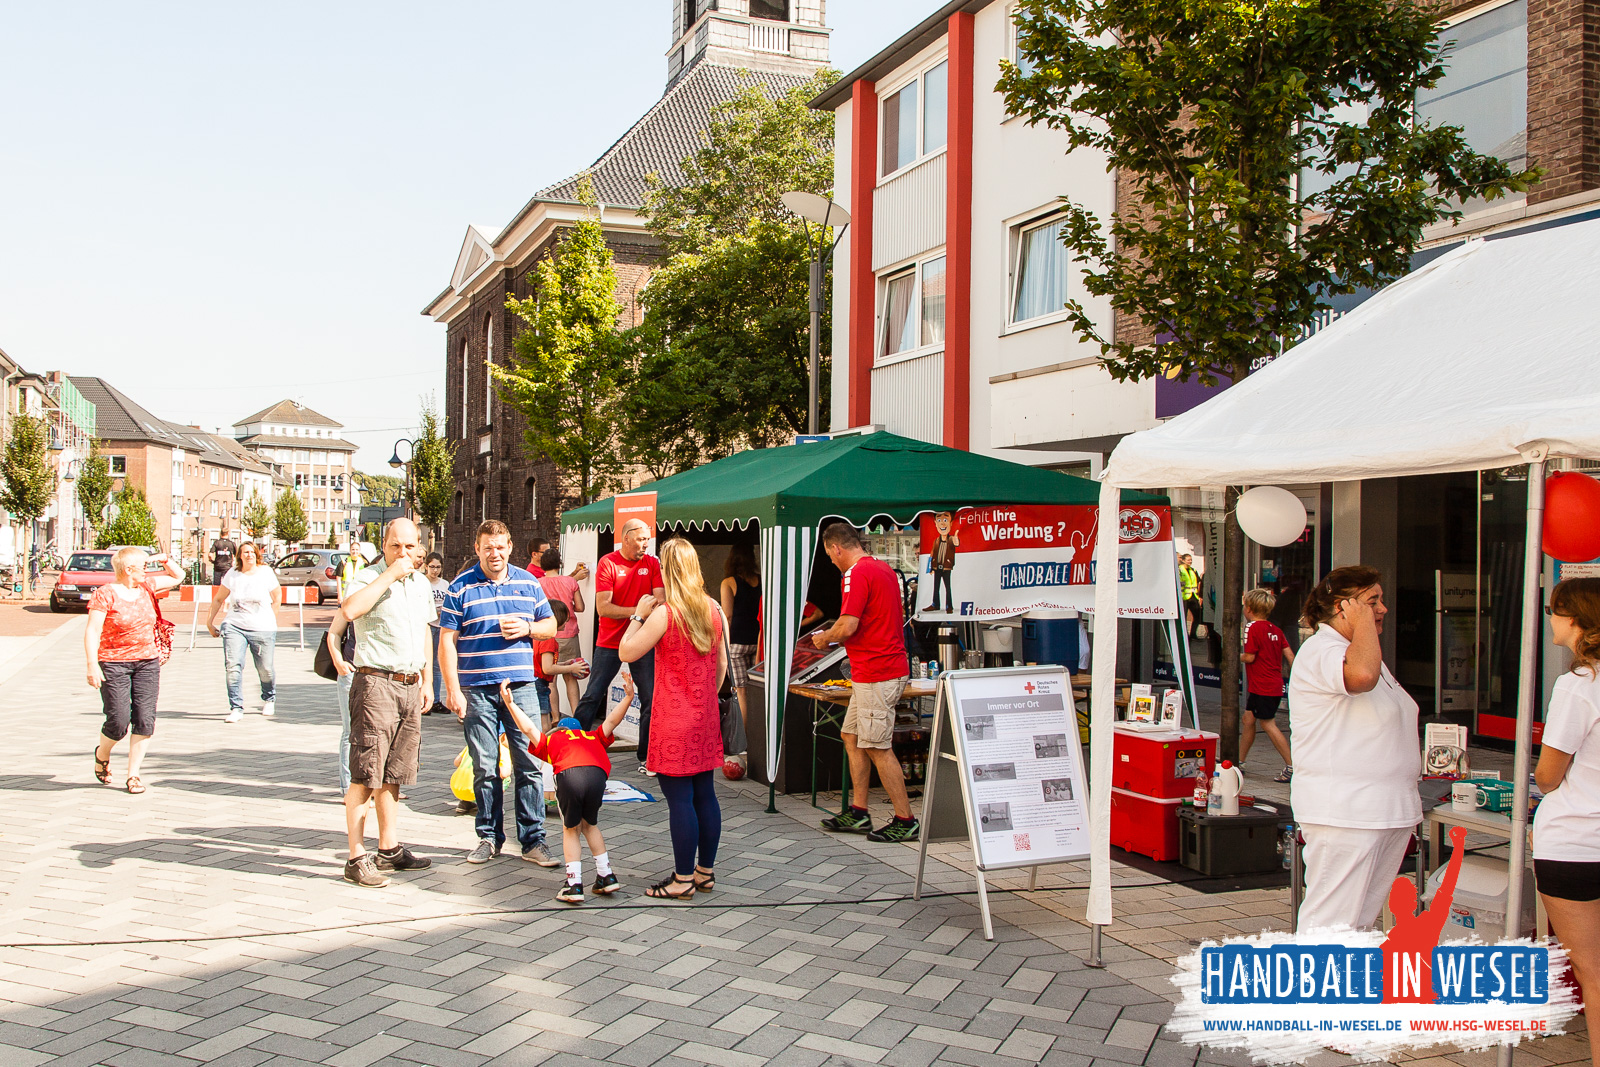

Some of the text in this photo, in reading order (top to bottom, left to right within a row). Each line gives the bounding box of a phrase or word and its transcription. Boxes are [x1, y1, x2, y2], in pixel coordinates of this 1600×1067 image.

[959, 509, 1017, 525] Fehlt Ihre
[1119, 515, 1155, 531] HSG
[980, 521, 1066, 543] Werbung ?
[1002, 564, 1069, 587] HANDBALL
[1072, 563, 1086, 584] IN
[987, 702, 1012, 711] Immer
[1027, 700, 1040, 708] Ort
